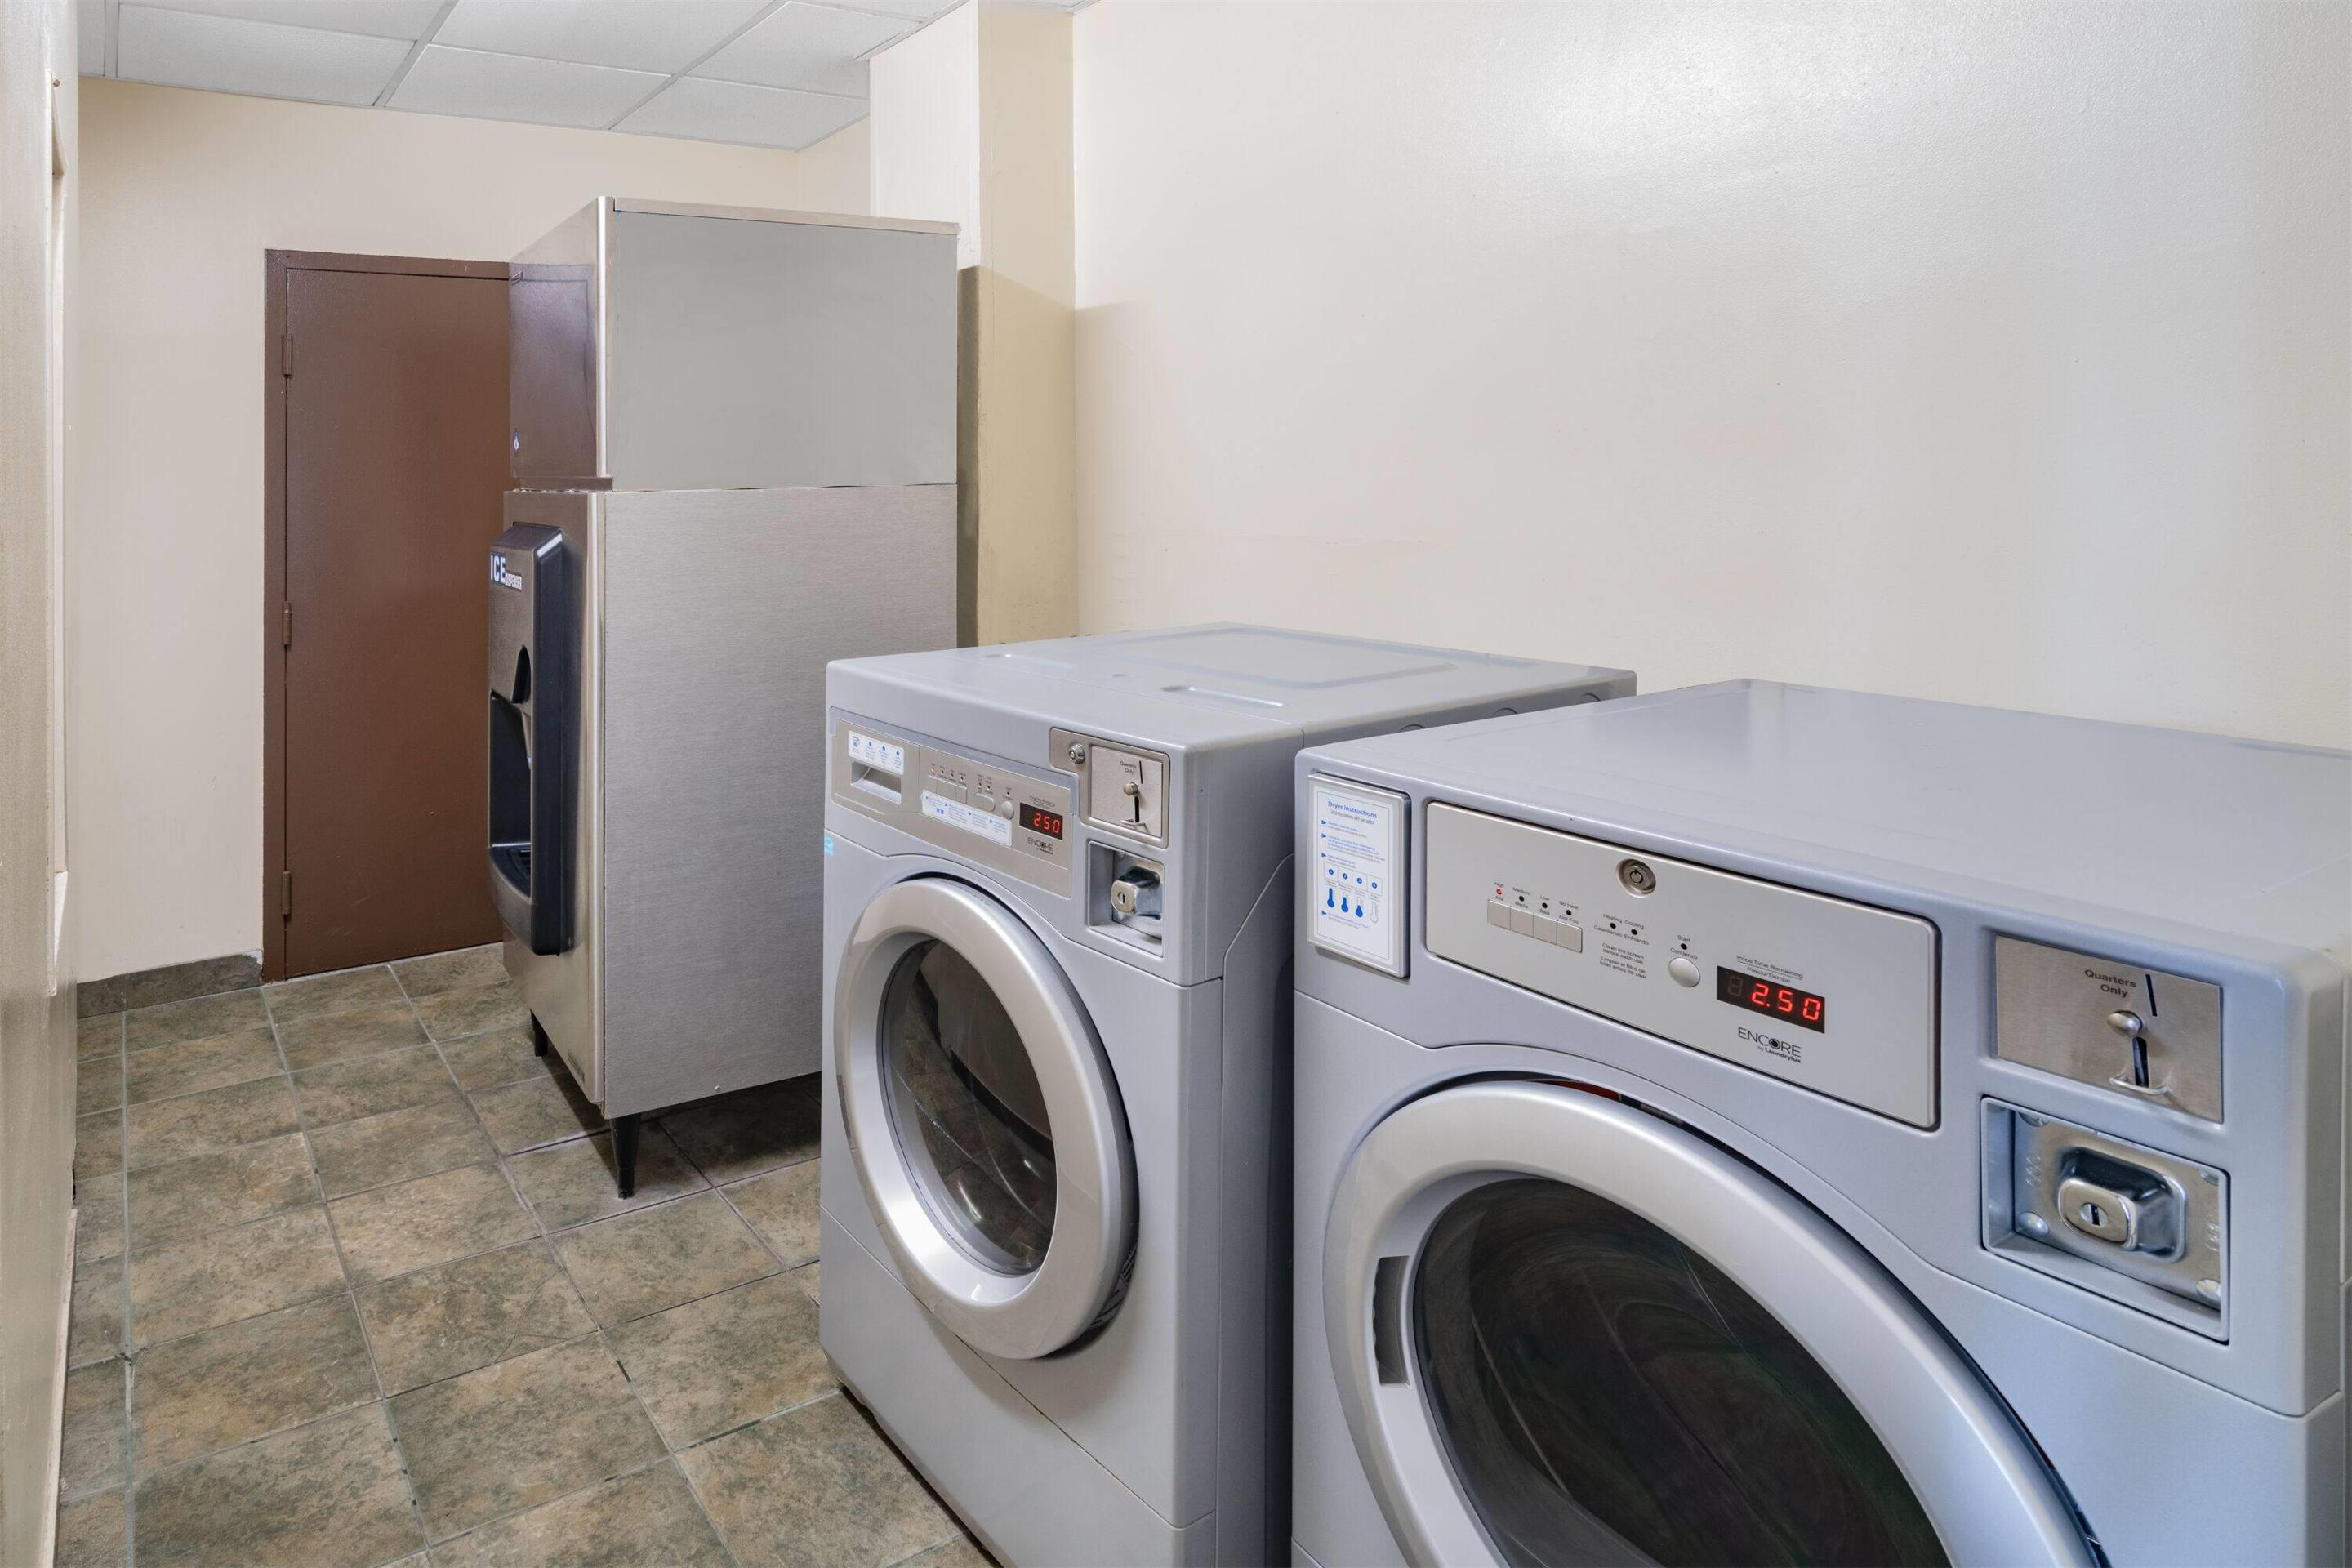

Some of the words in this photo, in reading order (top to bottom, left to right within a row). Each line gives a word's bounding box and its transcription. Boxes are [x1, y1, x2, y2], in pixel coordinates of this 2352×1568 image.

[490, 554, 506, 584] ICE
[1327, 800, 1343, 811] Dryer
[1343, 804, 1378, 819] Instructions
[1033, 812, 1061, 834] 2.50
[1603, 914, 1623, 924] Heating
[1624, 920, 1645, 930] Cooling
[1677, 934, 1691, 943] Start
[1670, 947, 1699, 960] Comienzo
[1736, 955, 1769, 969] Price/Time
[1770, 964, 1803, 979] Remaining
[1747, 966, 1791, 983] Precio/Tiempo
[2084, 969, 2137, 988] Quarters
[2100, 983, 2128, 998] Only
[1750, 982, 1821, 1022] 2.50
[1737, 1027, 1802, 1058] ENCORE
[1765, 1046, 1802, 1063] Laundrylux
